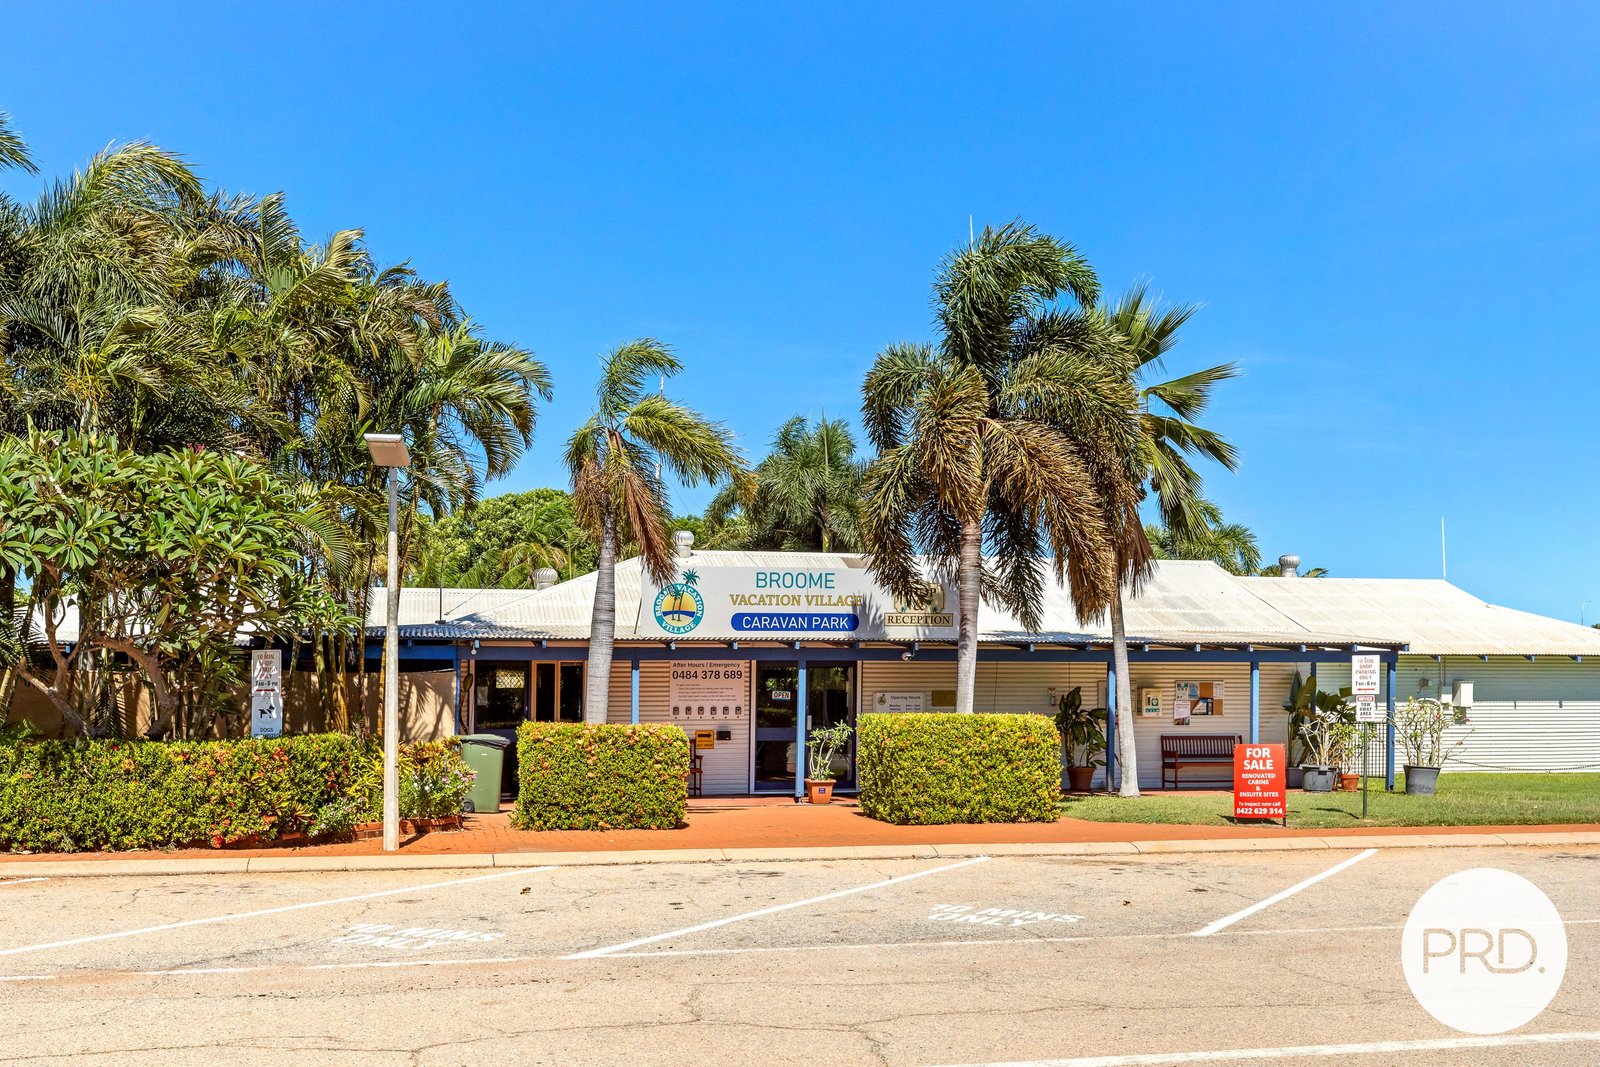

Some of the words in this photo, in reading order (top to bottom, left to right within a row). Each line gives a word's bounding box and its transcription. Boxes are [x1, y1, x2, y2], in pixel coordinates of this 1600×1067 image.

[756, 572, 835, 589] BROOME
[677, 585, 702, 616] VACATION
[730, 594, 801, 606] VACATION
[805, 594, 862, 606] VILLAGE
[742, 616, 808, 628] CARAVAN
[812, 616, 848, 628] PARK
[888, 615, 950, 624] RECEPTION
[662, 622, 696, 633] VILLAGE
[672, 670, 698, 679] 0484
[701, 670, 720, 679] 378
[724, 670, 742, 679] 689
[1246, 748, 1270, 758] FOR
[1244, 760, 1274, 770] SALE
